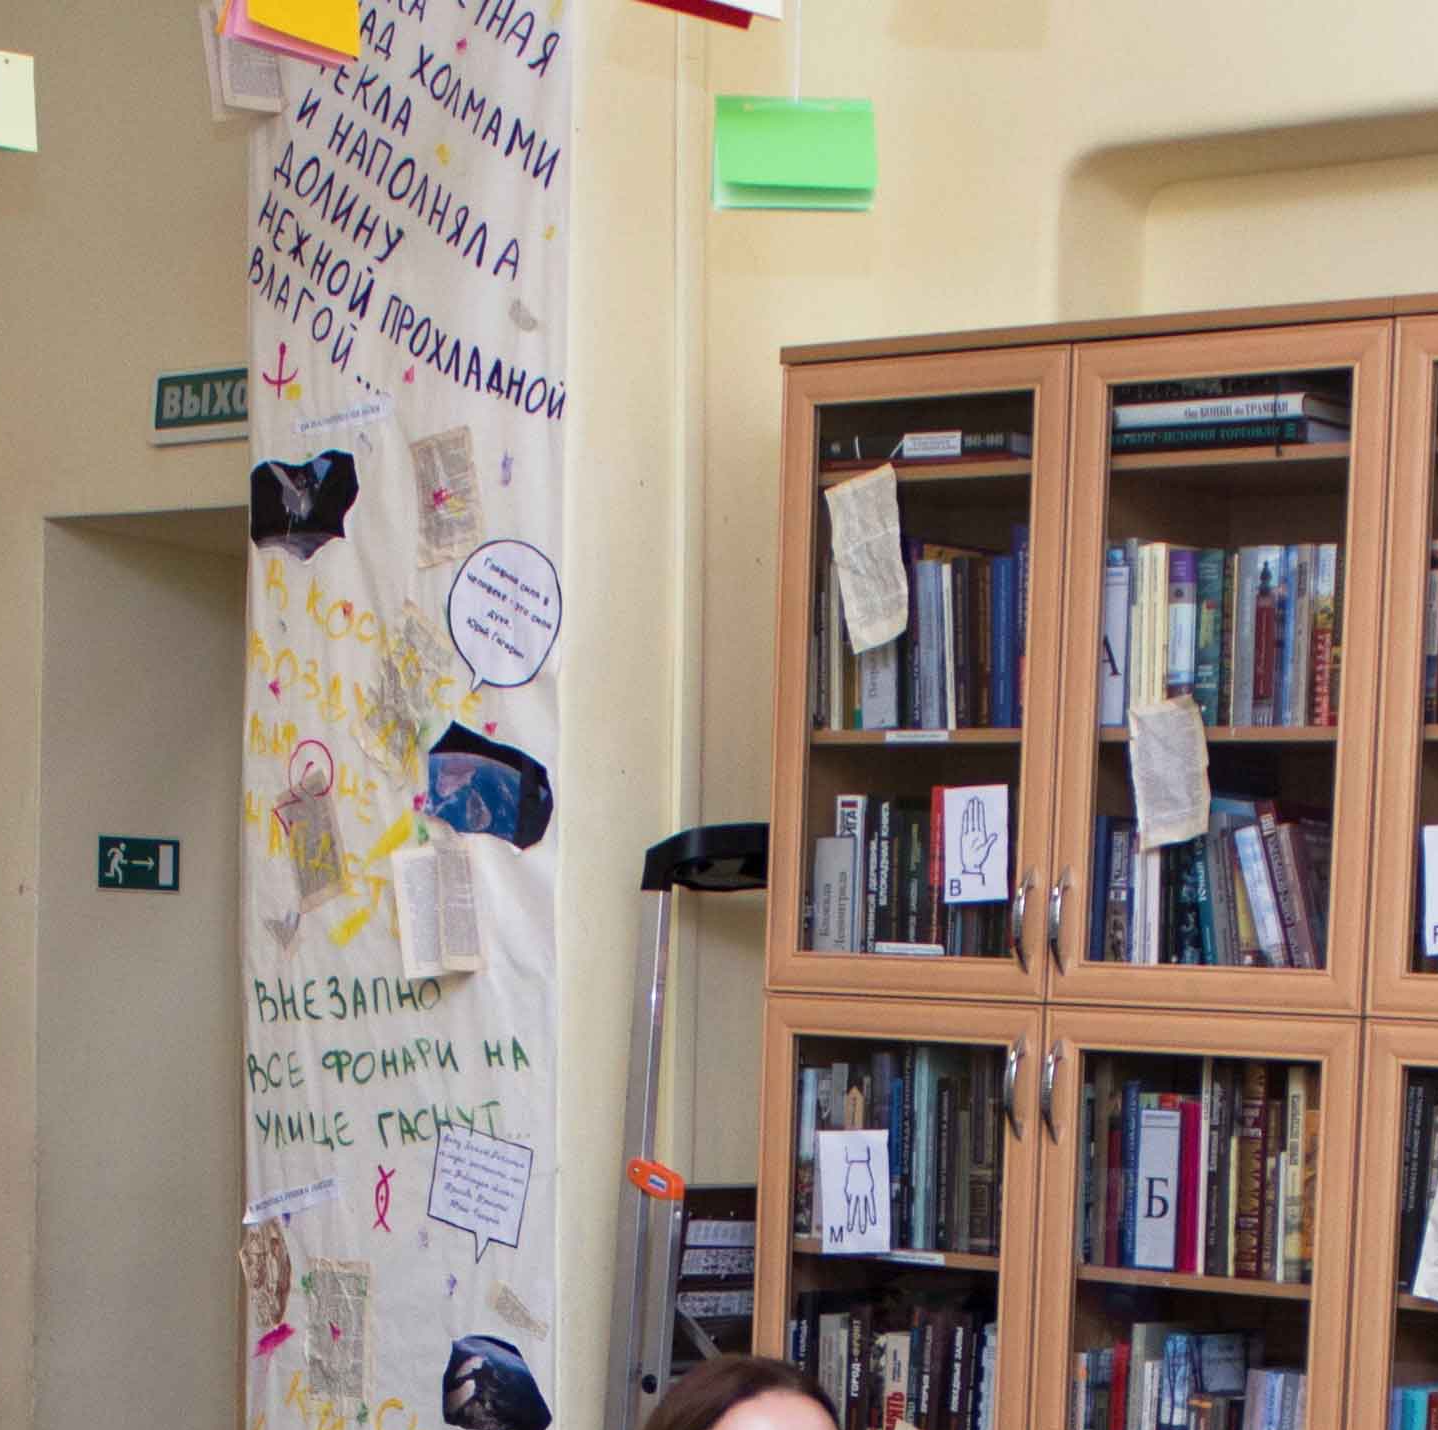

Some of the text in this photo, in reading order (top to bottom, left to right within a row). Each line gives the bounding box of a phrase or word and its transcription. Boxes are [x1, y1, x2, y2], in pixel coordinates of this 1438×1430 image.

[319, 64, 413, 137] ЕКЛА
[358, 8, 396, 61] АД
[410, 44, 561, 190] ХОЛМАМИ
[273, 140, 404, 262] ДОЛИНУ
[296, 87, 520, 281] И НАПОЛНЯЛА
[258, 189, 566, 420] НЕЖНОЙ ПРОХЛАДНОЙ
[161, 379, 248, 419] ВЫХО
[950, 878, 961, 897] В
[254, 975, 441, 1022] ВНЕЗАПНО
[246, 1035, 530, 1094] ВСЕ ФОНАРИ НА
[254, 1108, 354, 1151] УЛИЦЕ
[1146, 1177, 1169, 1219] Б
[830, 1227, 843, 1241] М
